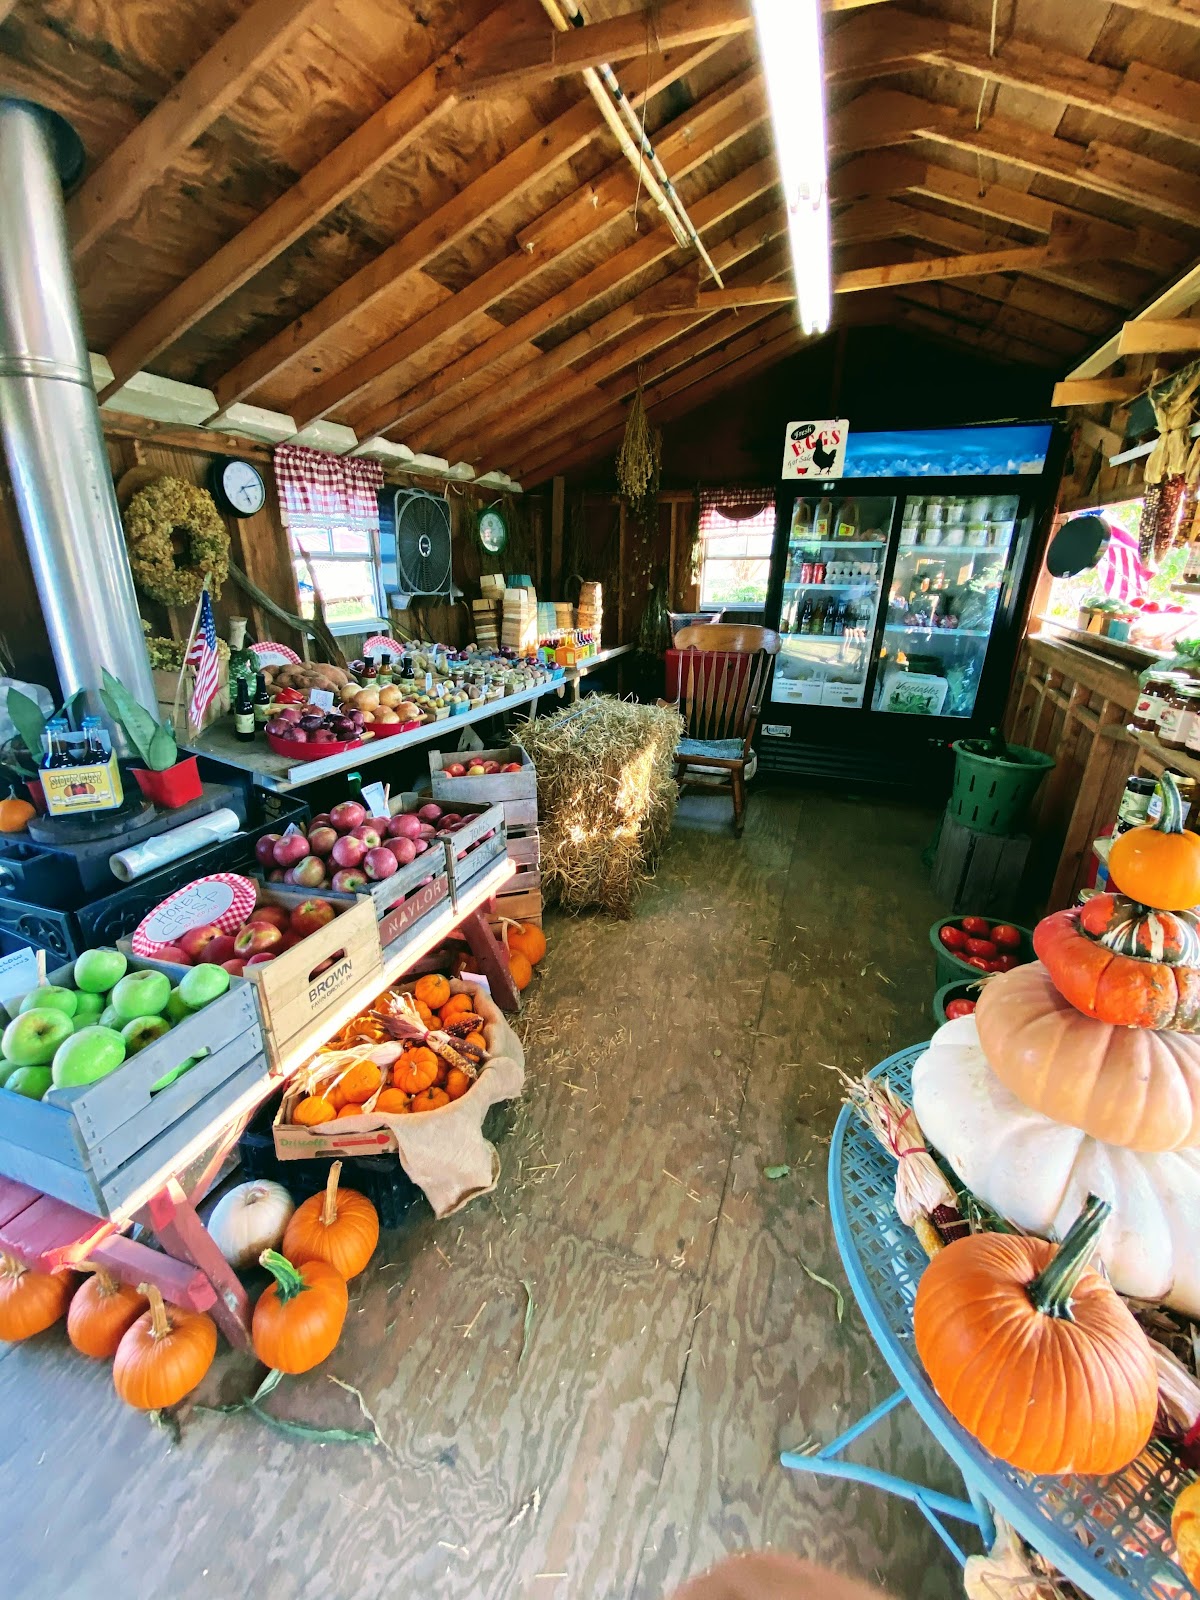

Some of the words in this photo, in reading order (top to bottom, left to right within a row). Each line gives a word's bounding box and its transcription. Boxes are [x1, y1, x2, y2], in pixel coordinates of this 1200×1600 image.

[791, 430, 841, 457] EGGS
[794, 425, 812, 439] Fresh
[788, 459, 798, 468] For
[799, 454, 812, 463] Sale
[895, 682, 940, 696] Vegetables
[79, 771, 102, 784] CITY
[155, 888, 201, 924] HONEY
[162, 891, 218, 936] CRISP
[388, 880, 441, 935] NAYLOR
[308, 959, 353, 1003] BROWN
